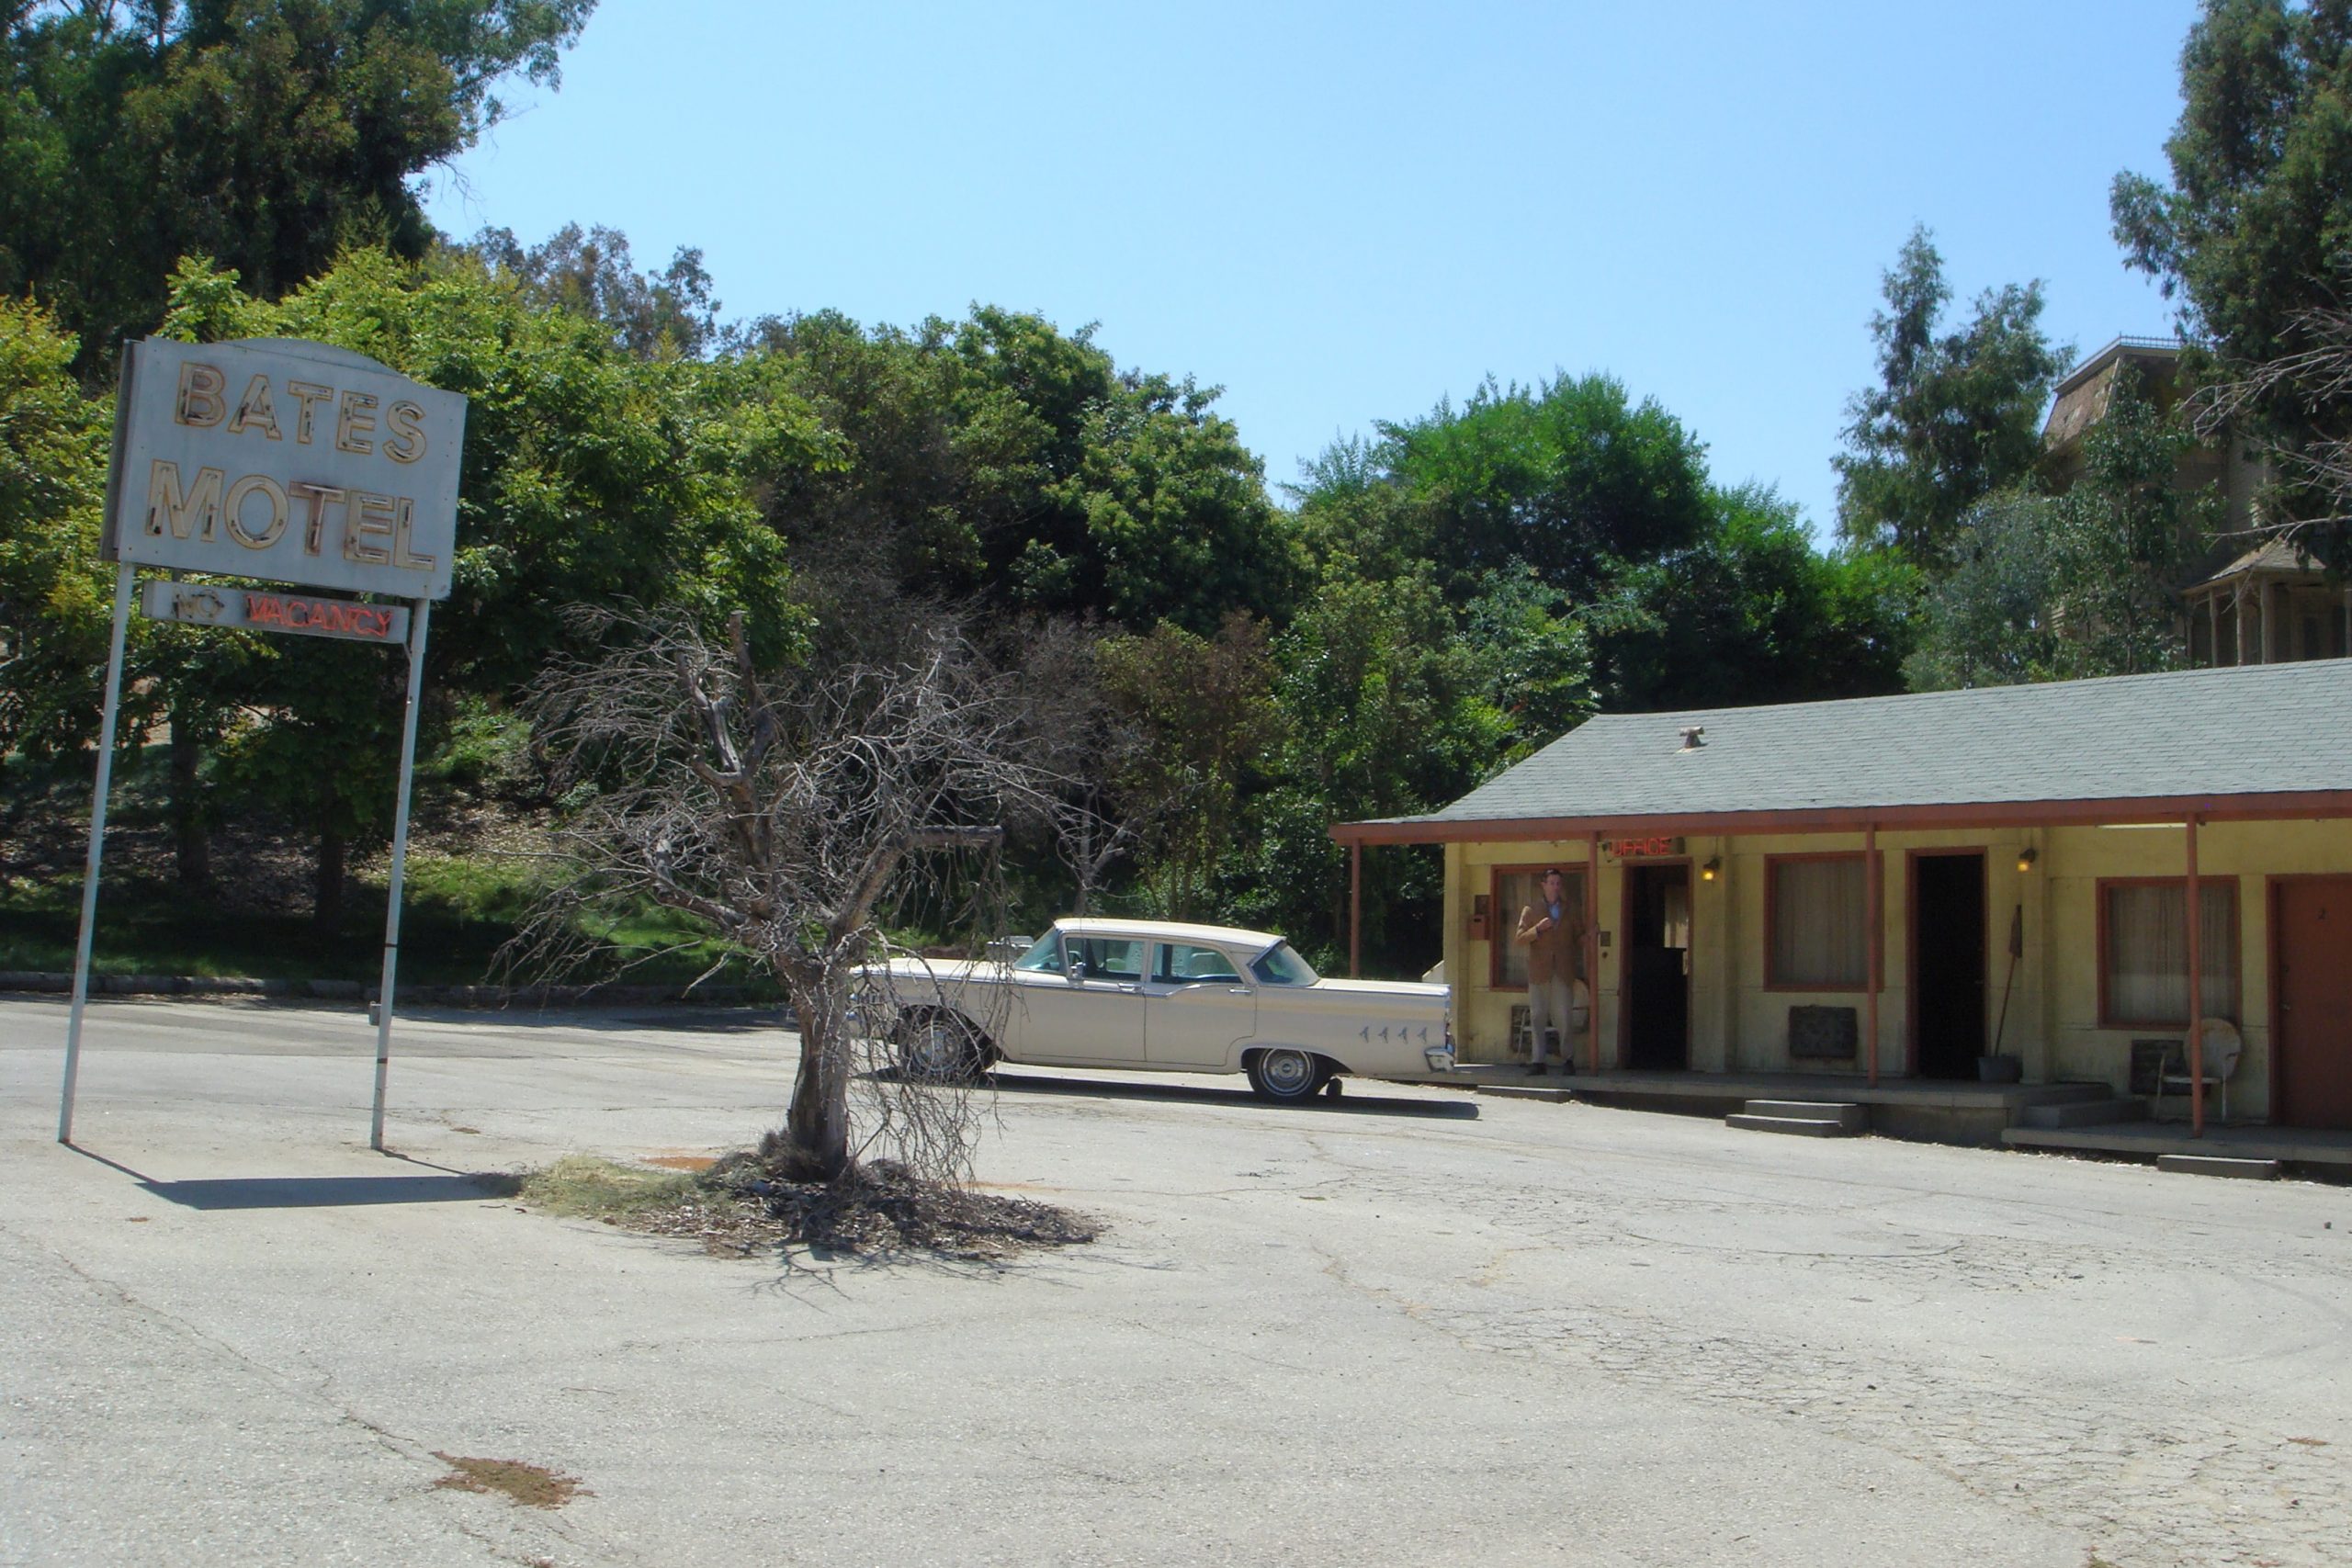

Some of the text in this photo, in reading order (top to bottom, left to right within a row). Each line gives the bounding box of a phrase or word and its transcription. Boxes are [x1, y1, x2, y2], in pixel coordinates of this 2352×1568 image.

[175, 362, 427, 464] BATES
[145, 459, 436, 571] MOTEL
[173, 586, 393, 637] NO VACANCY
[1611, 837, 1671, 857] OFFICE
